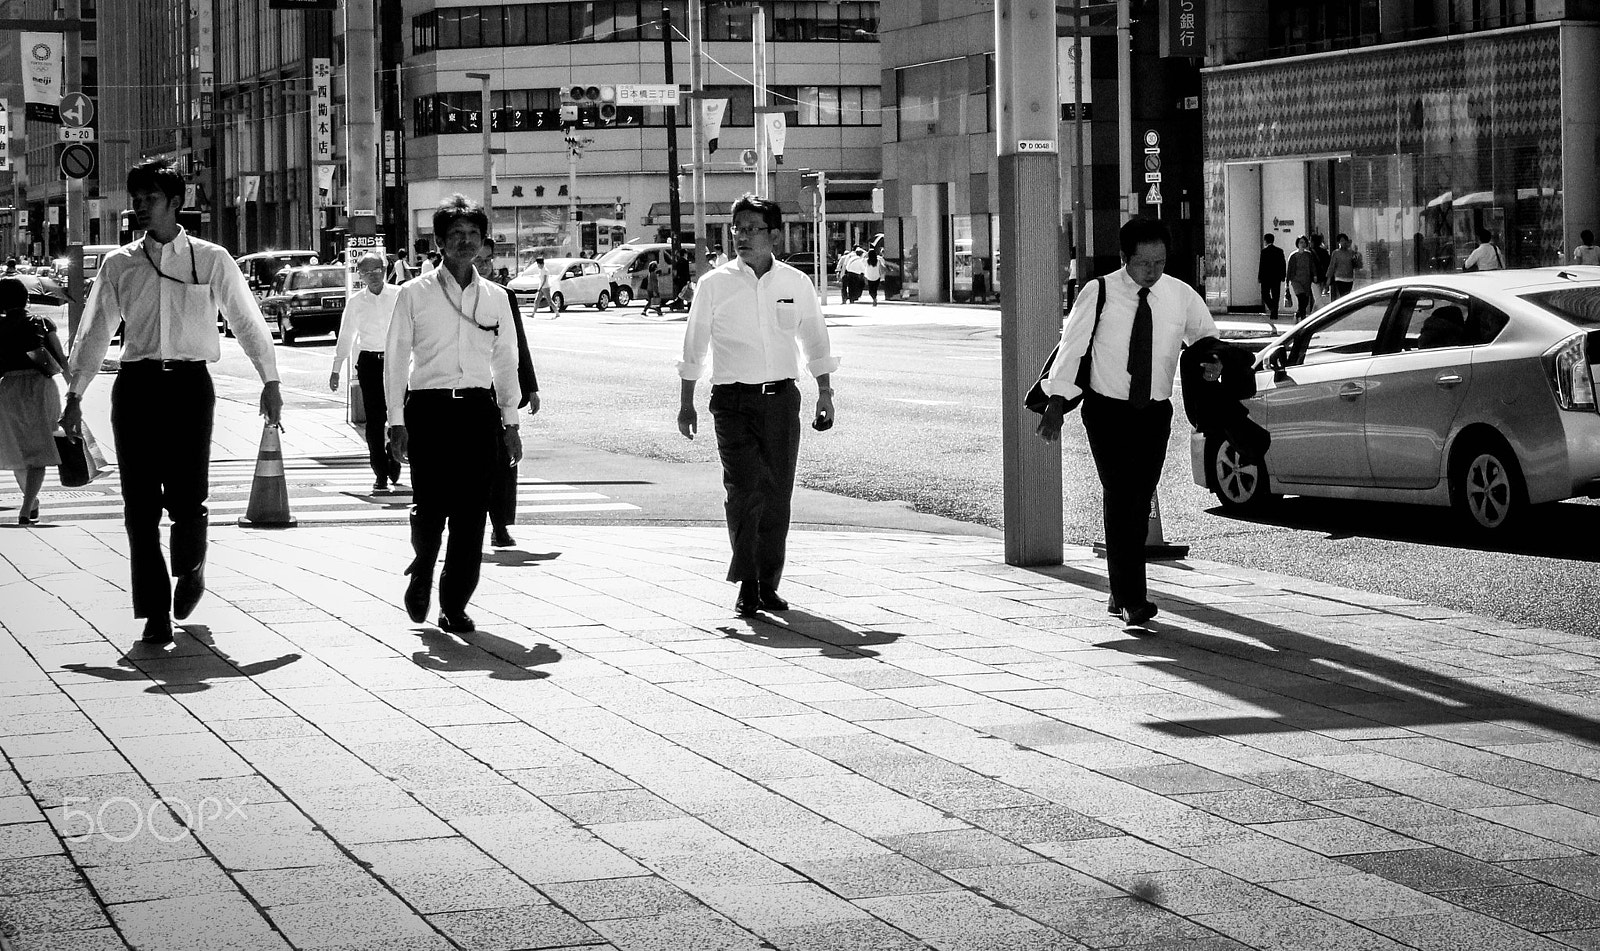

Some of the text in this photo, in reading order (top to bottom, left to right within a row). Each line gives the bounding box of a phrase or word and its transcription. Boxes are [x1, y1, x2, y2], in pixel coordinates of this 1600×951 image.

[1180, 0, 1194, 47] ら銀行
[621, 90, 675, 98] 日本橋三丁目
[347, 237, 384, 247] お知らせ
